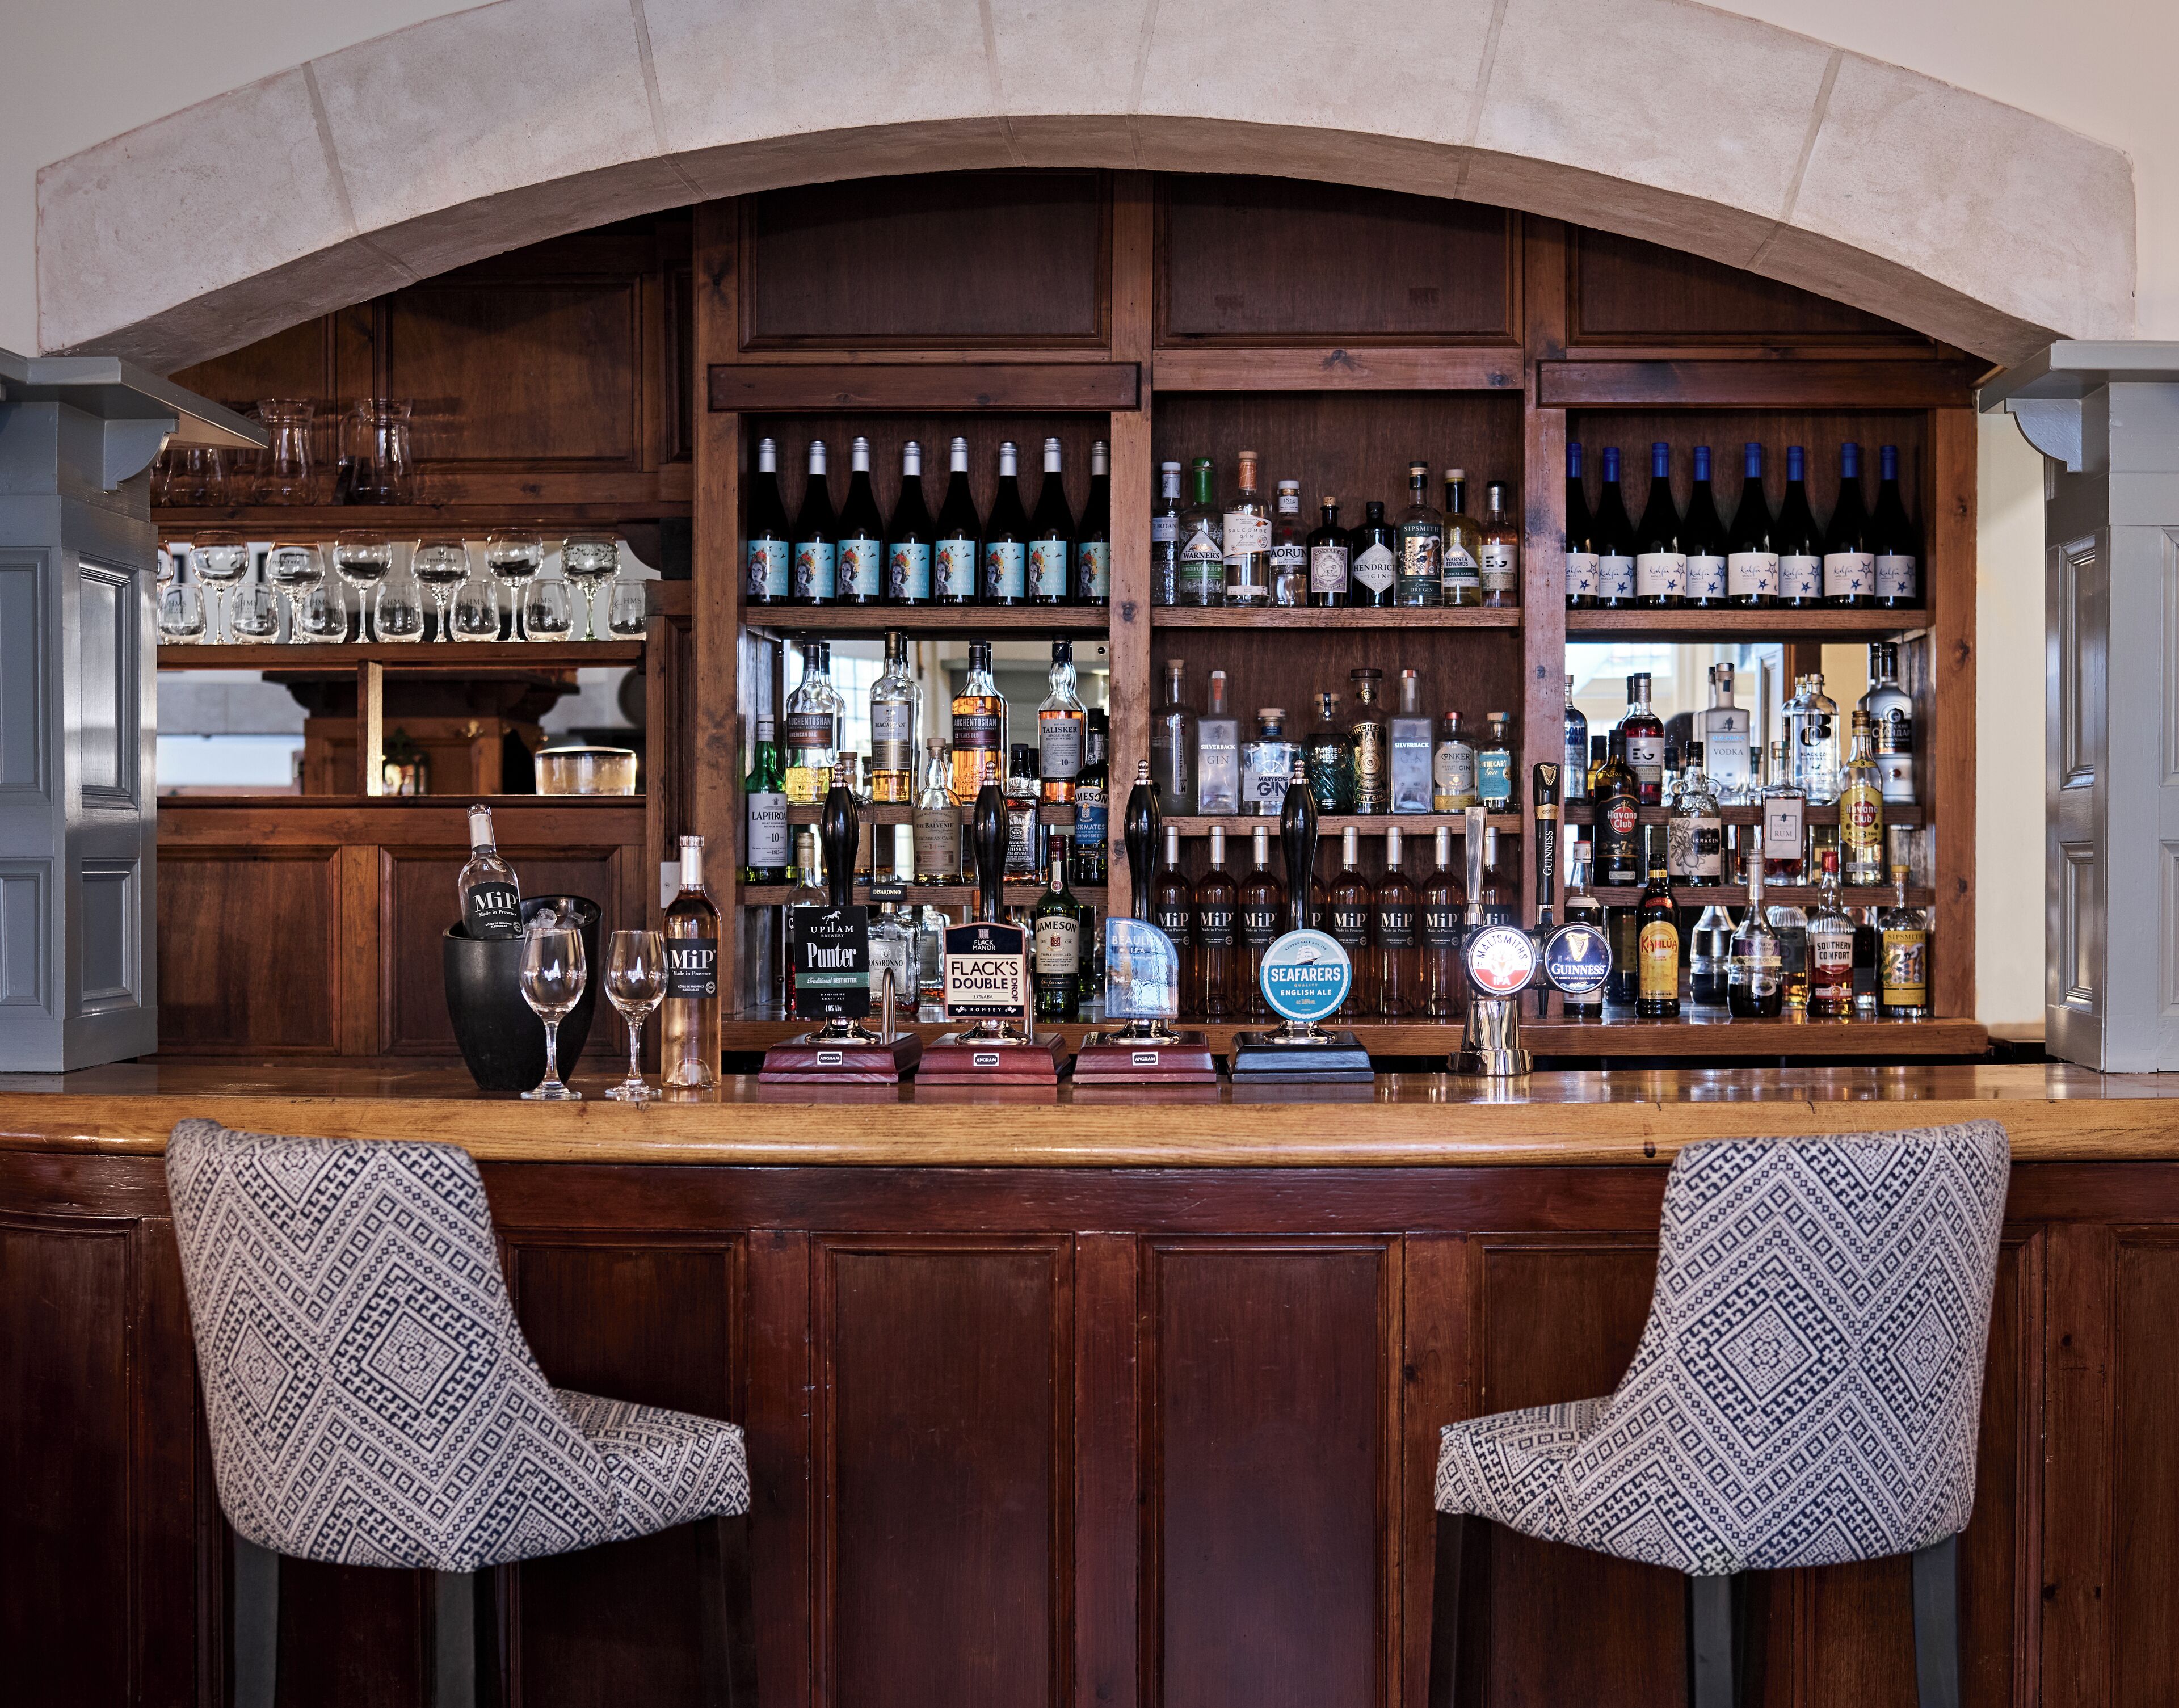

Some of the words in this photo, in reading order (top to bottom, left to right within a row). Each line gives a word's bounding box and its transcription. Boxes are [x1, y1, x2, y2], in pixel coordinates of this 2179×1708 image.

[1271, 549, 1307, 558] AORUN
[1351, 725, 1381, 736] WINCHES
[1633, 748, 1654, 760] EG
[1207, 756, 1229, 764] GIN
[1257, 782, 1288, 796] GIN
[1846, 805, 1878, 814] Havana
[752, 811, 787, 820] LAPHROA
[1608, 811, 1637, 819] Havana
[1852, 814, 1872, 823] Club
[1614, 819, 1632, 828] Club
[772, 833, 779, 842] 10
[1621, 841, 1627, 850] 7
[1543, 831, 1553, 876] GUINNESS
[810, 922, 853, 933] UPHAM
[1037, 921, 1076, 933] JAMESON
[1285, 941, 1299, 951] GEORGE
[1476, 934, 1528, 960] MALTSMITHS
[1641, 936, 1677, 954] KAHLÚA
[1817, 941, 1851, 950] SOUTHERN
[807, 943, 857, 967] Punter
[1819, 951, 1849, 960] COMFORT
[952, 961, 1018, 975] FLACK'S
[1551, 963, 1606, 975] GUINNESS
[1271, 967, 1340, 982] SEAFARERS
[953, 978, 1008, 989] DOUBLE
[1493, 976, 1511, 985] IPA
